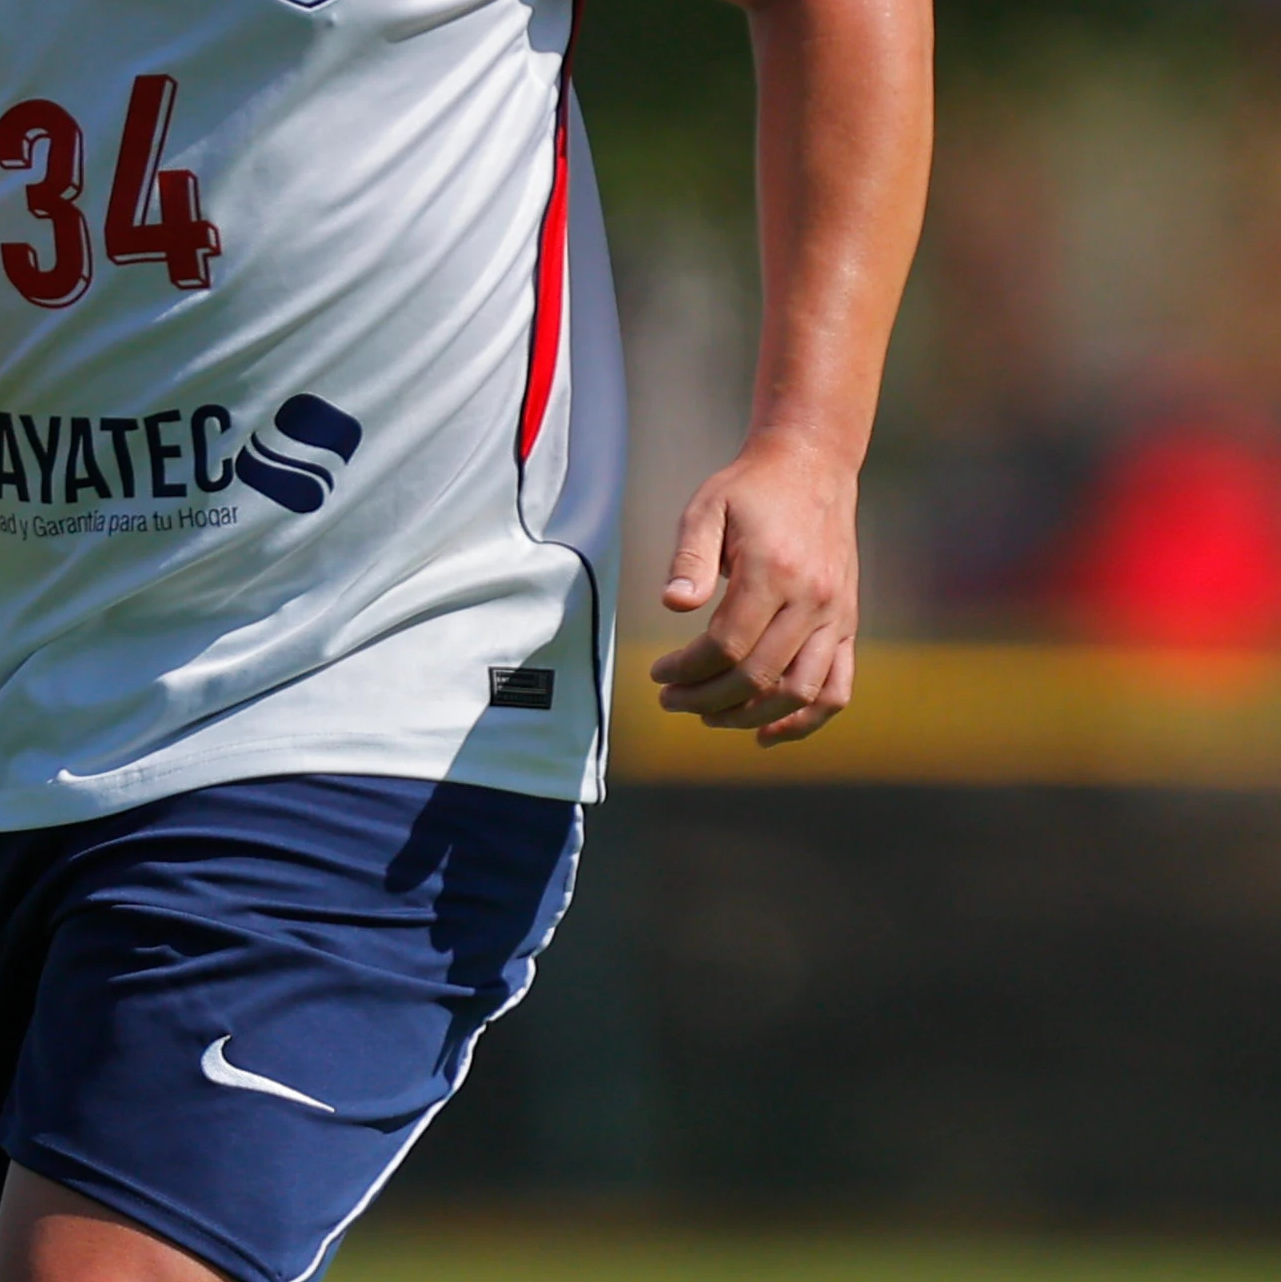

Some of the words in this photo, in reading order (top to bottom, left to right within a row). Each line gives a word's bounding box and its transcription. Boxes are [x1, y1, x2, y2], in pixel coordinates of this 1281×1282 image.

[19, 519, 29, 541] y
[108, 514, 147, 537] para
[153, 510, 173, 531] tu
